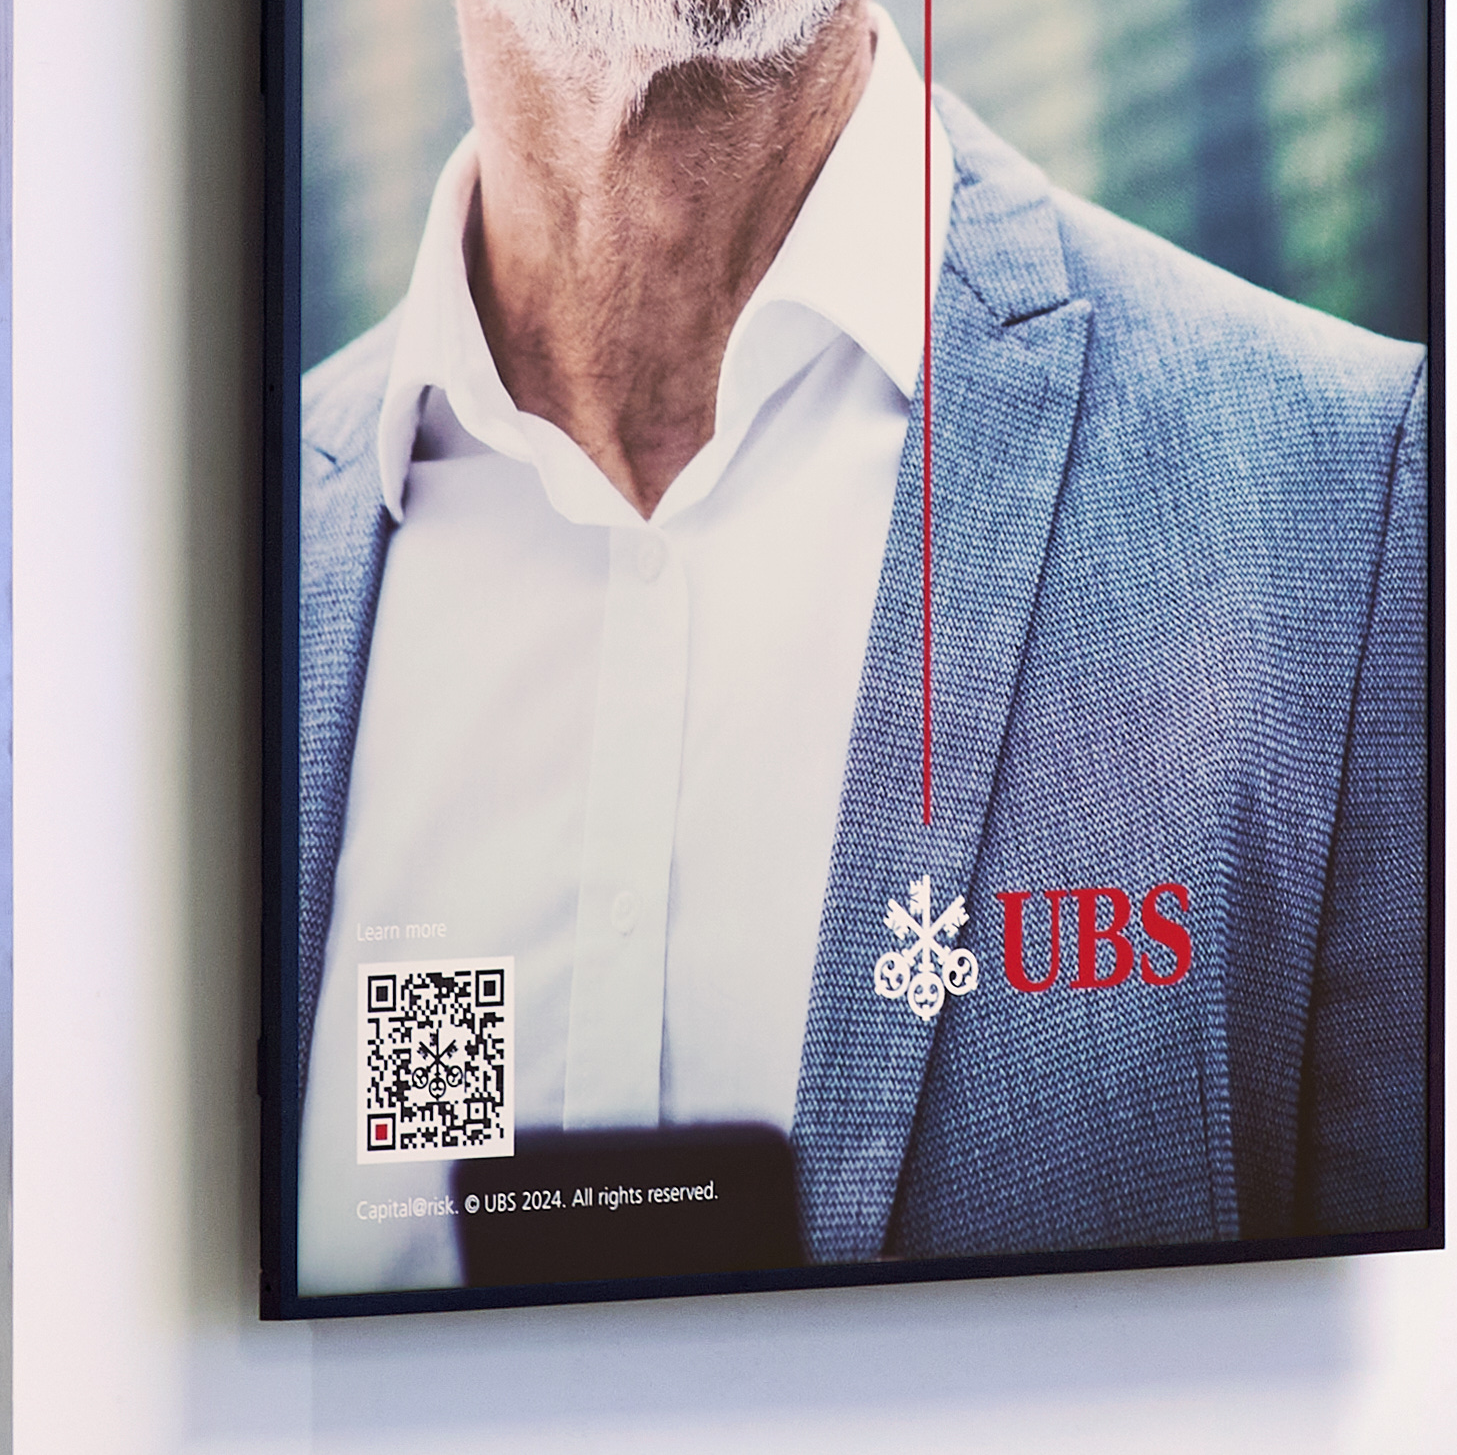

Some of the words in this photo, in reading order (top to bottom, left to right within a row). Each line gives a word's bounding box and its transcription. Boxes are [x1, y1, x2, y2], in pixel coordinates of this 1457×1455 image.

[356, 922, 401, 942] Learn
[405, 921, 448, 939] more
[996, 882, 1193, 994] UBS
[356, 1195, 460, 1224] Capital@risk.
[484, 1191, 516, 1214] UBS
[522, 1190, 567, 1212] 2024.
[571, 1188, 594, 1209] All
[597, 1185, 643, 1213] rights
[647, 1180, 720, 1206] reserved.
